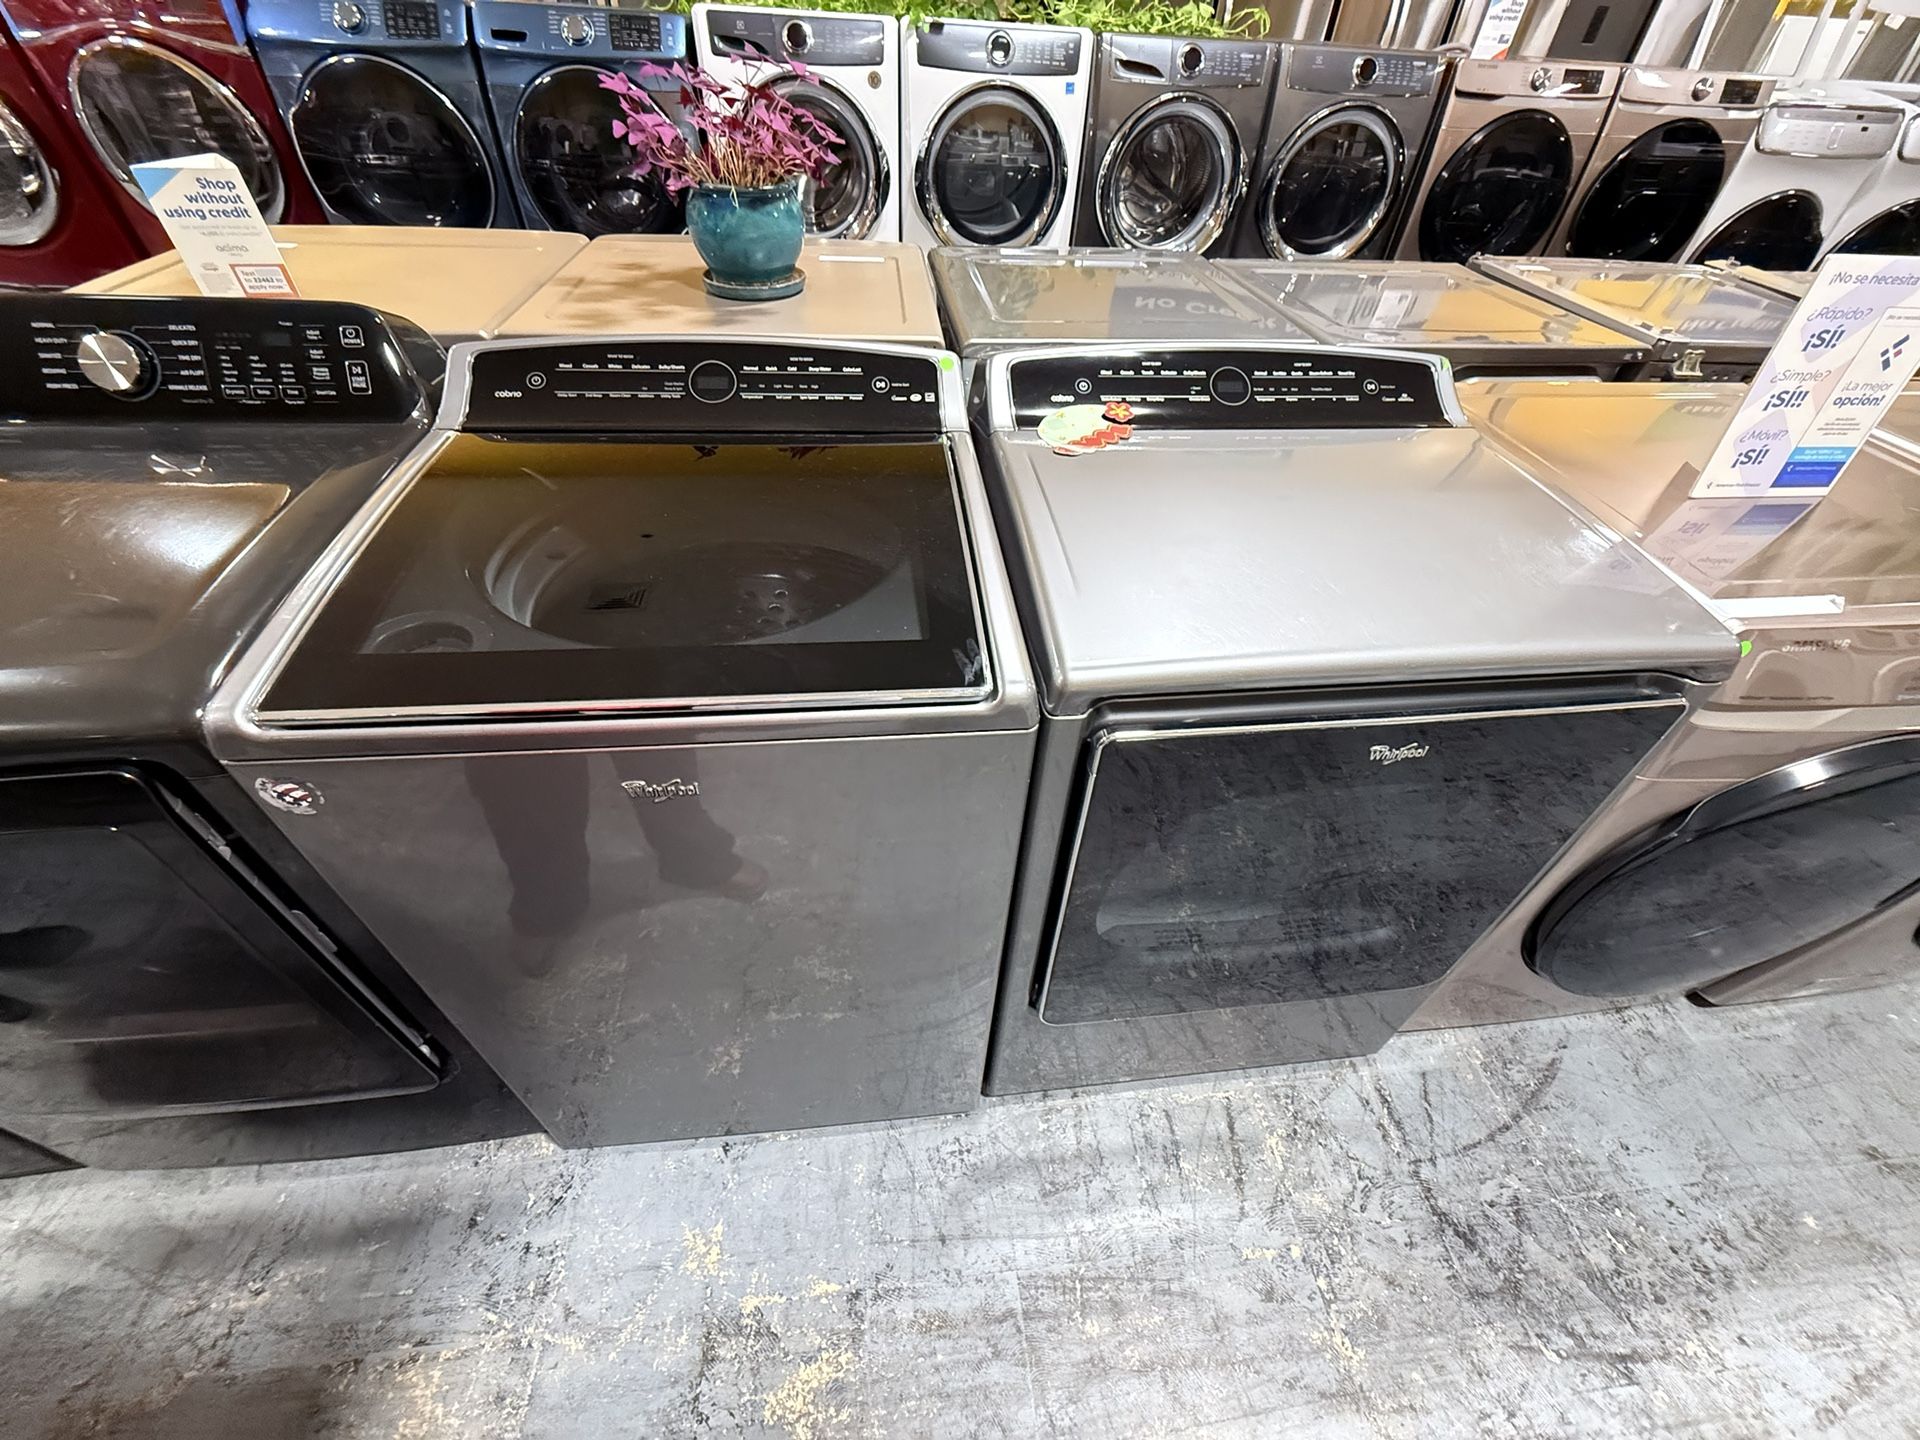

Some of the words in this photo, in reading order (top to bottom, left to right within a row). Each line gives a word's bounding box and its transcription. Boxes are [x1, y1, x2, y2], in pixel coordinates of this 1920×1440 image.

[195, 177, 236, 192] Shop
[184, 192, 245, 205] without
[163, 206, 207, 220] using
[209, 206, 251, 219] credit
[215, 244, 249, 253] acima
[1829, 272, 1851, 286] ¡No
[1852, 276, 1867, 285] se
[1868, 272, 1920, 287] necesita
[1806, 306, 1873, 321] ¿Rápido?
[1801, 324, 1846, 352] ¡SÍ!
[1770, 369, 1832, 384] ¿Simple?
[494, 390, 522, 398] cabrio
[1841, 381, 1859, 393] ¡La
[1860, 381, 1894, 394] mejor
[1833, 393, 1886, 409] opción!
[1739, 429, 1789, 444] ¿Móvil?
[1730, 444, 1770, 468] ¡SÍ!
[1369, 742, 1430, 766] Whirlpool
[621, 778, 699, 803] Whirlpool
